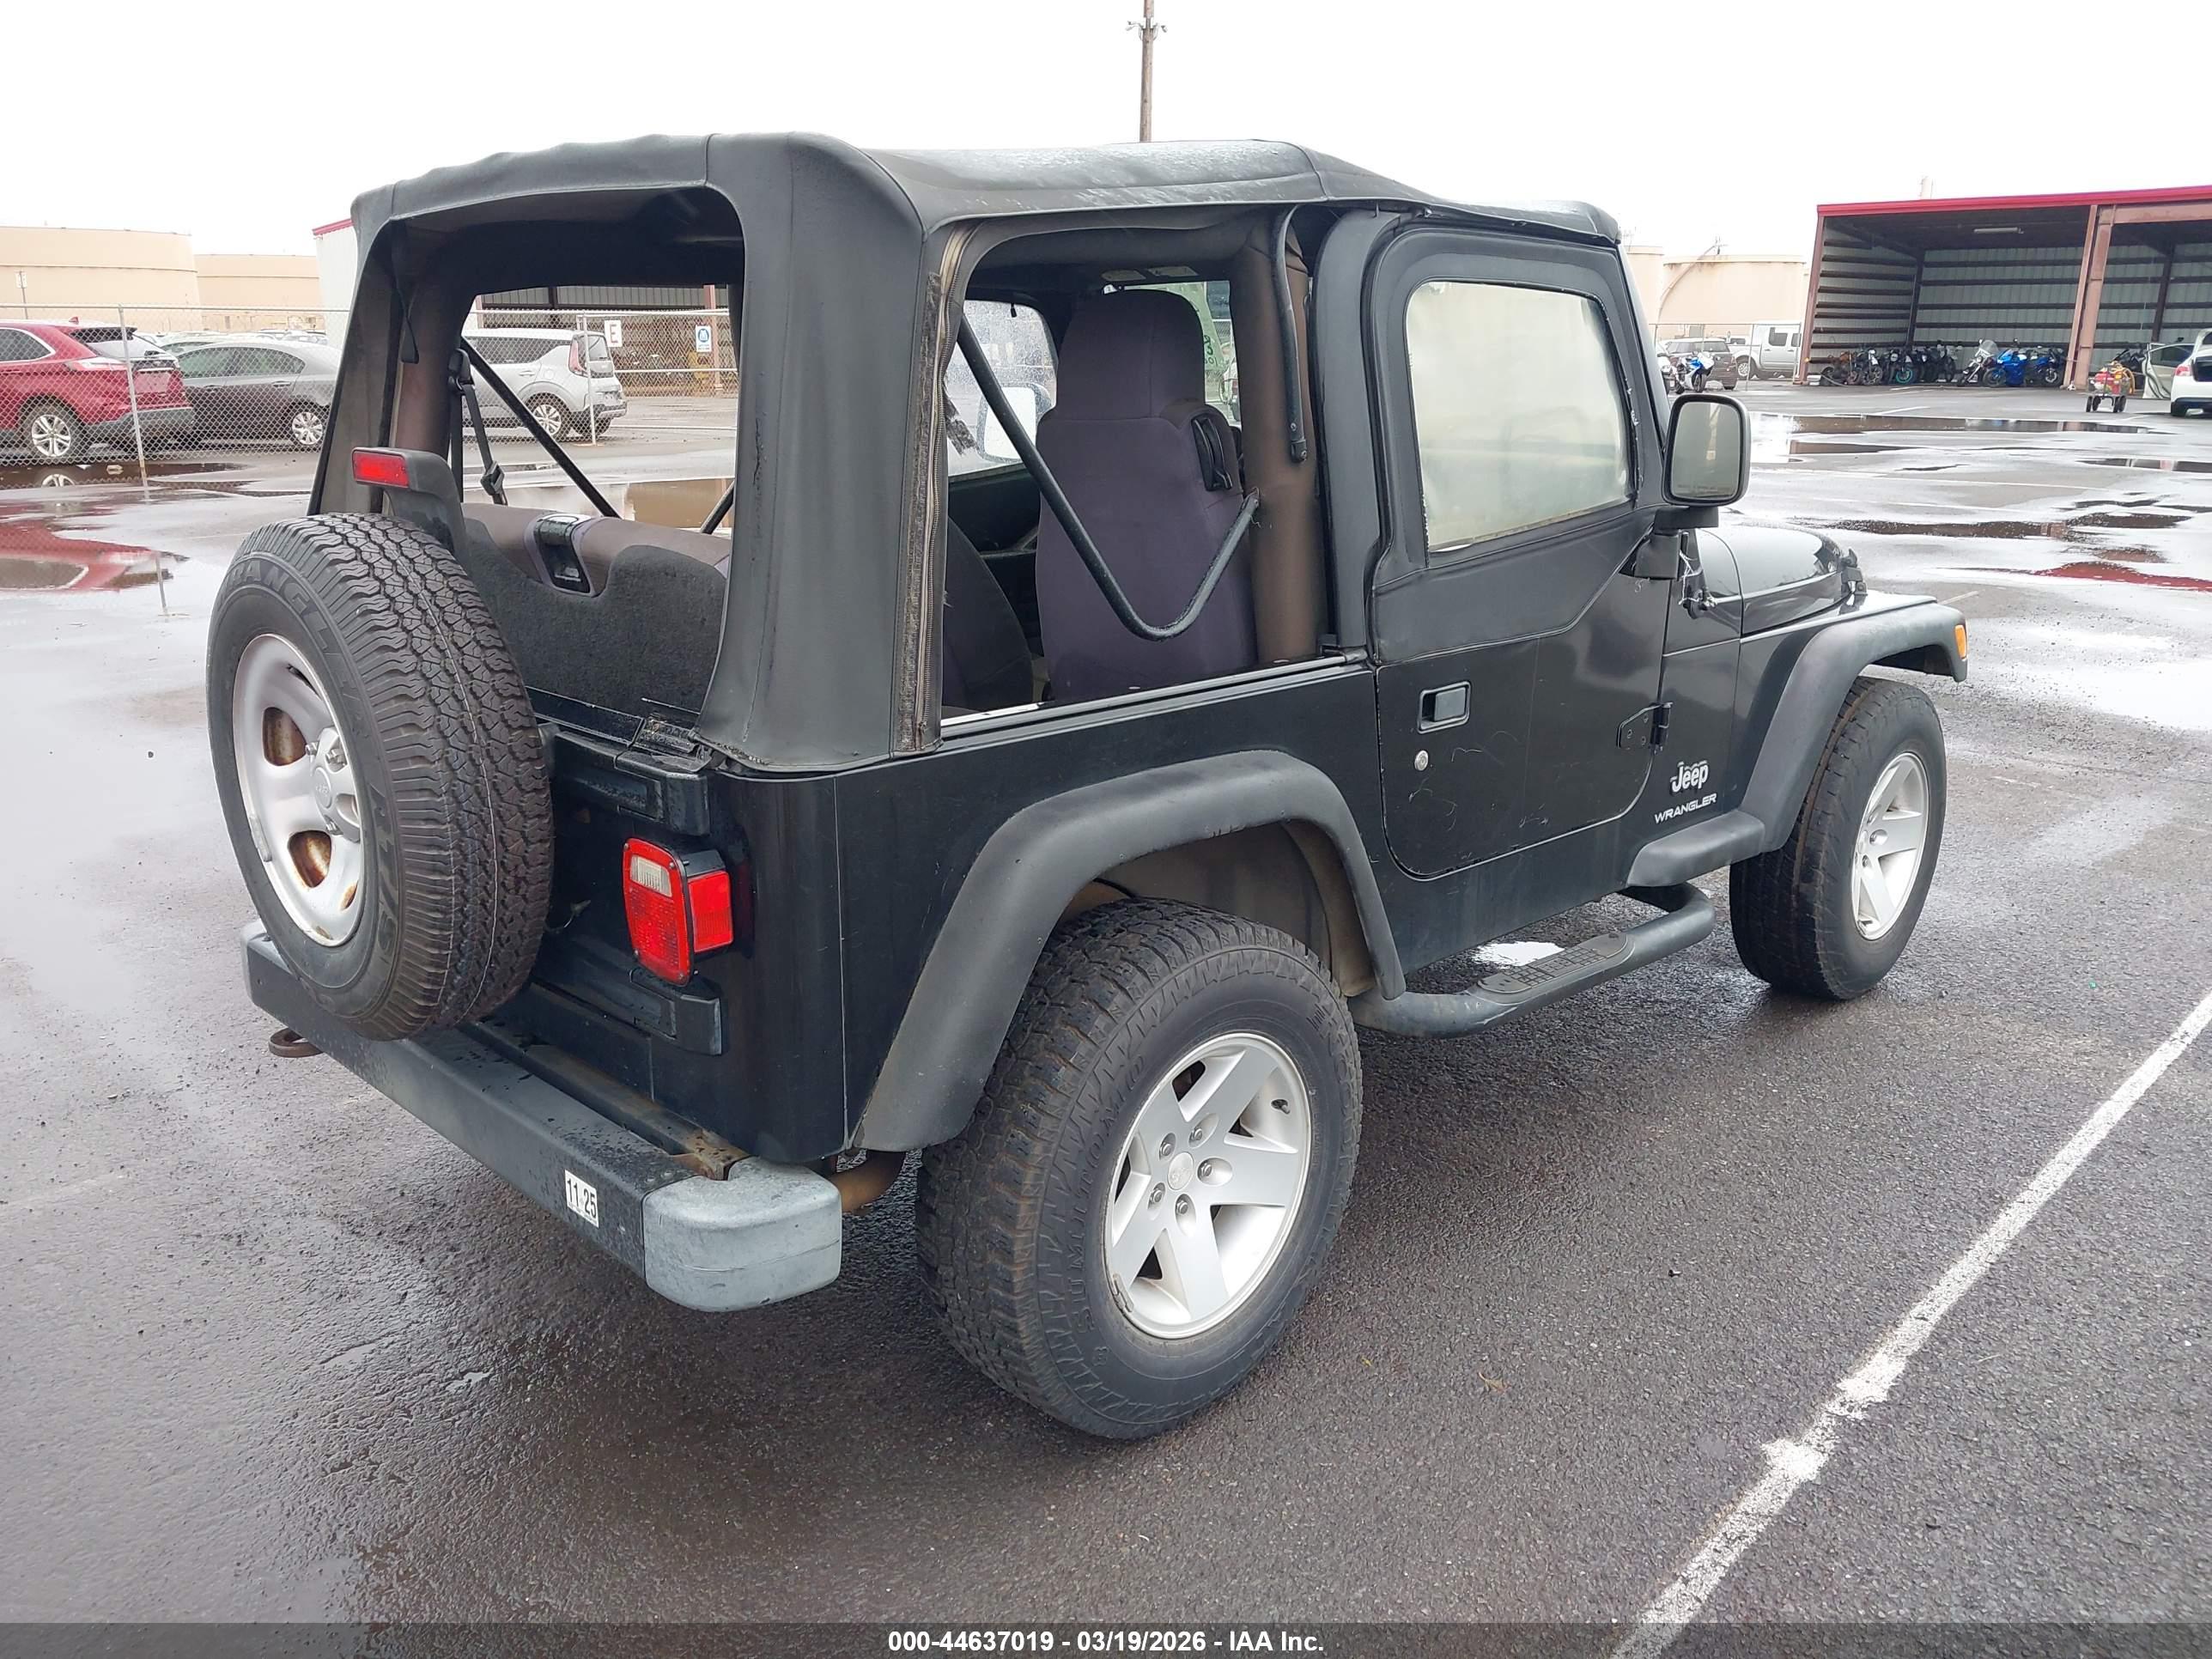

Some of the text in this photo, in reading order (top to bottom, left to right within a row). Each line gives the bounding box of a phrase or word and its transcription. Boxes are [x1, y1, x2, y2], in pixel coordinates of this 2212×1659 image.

[609, 324, 618, 343] E
[1670, 760, 1709, 793] Jeep
[1654, 793, 1717, 824] WRANGLER
